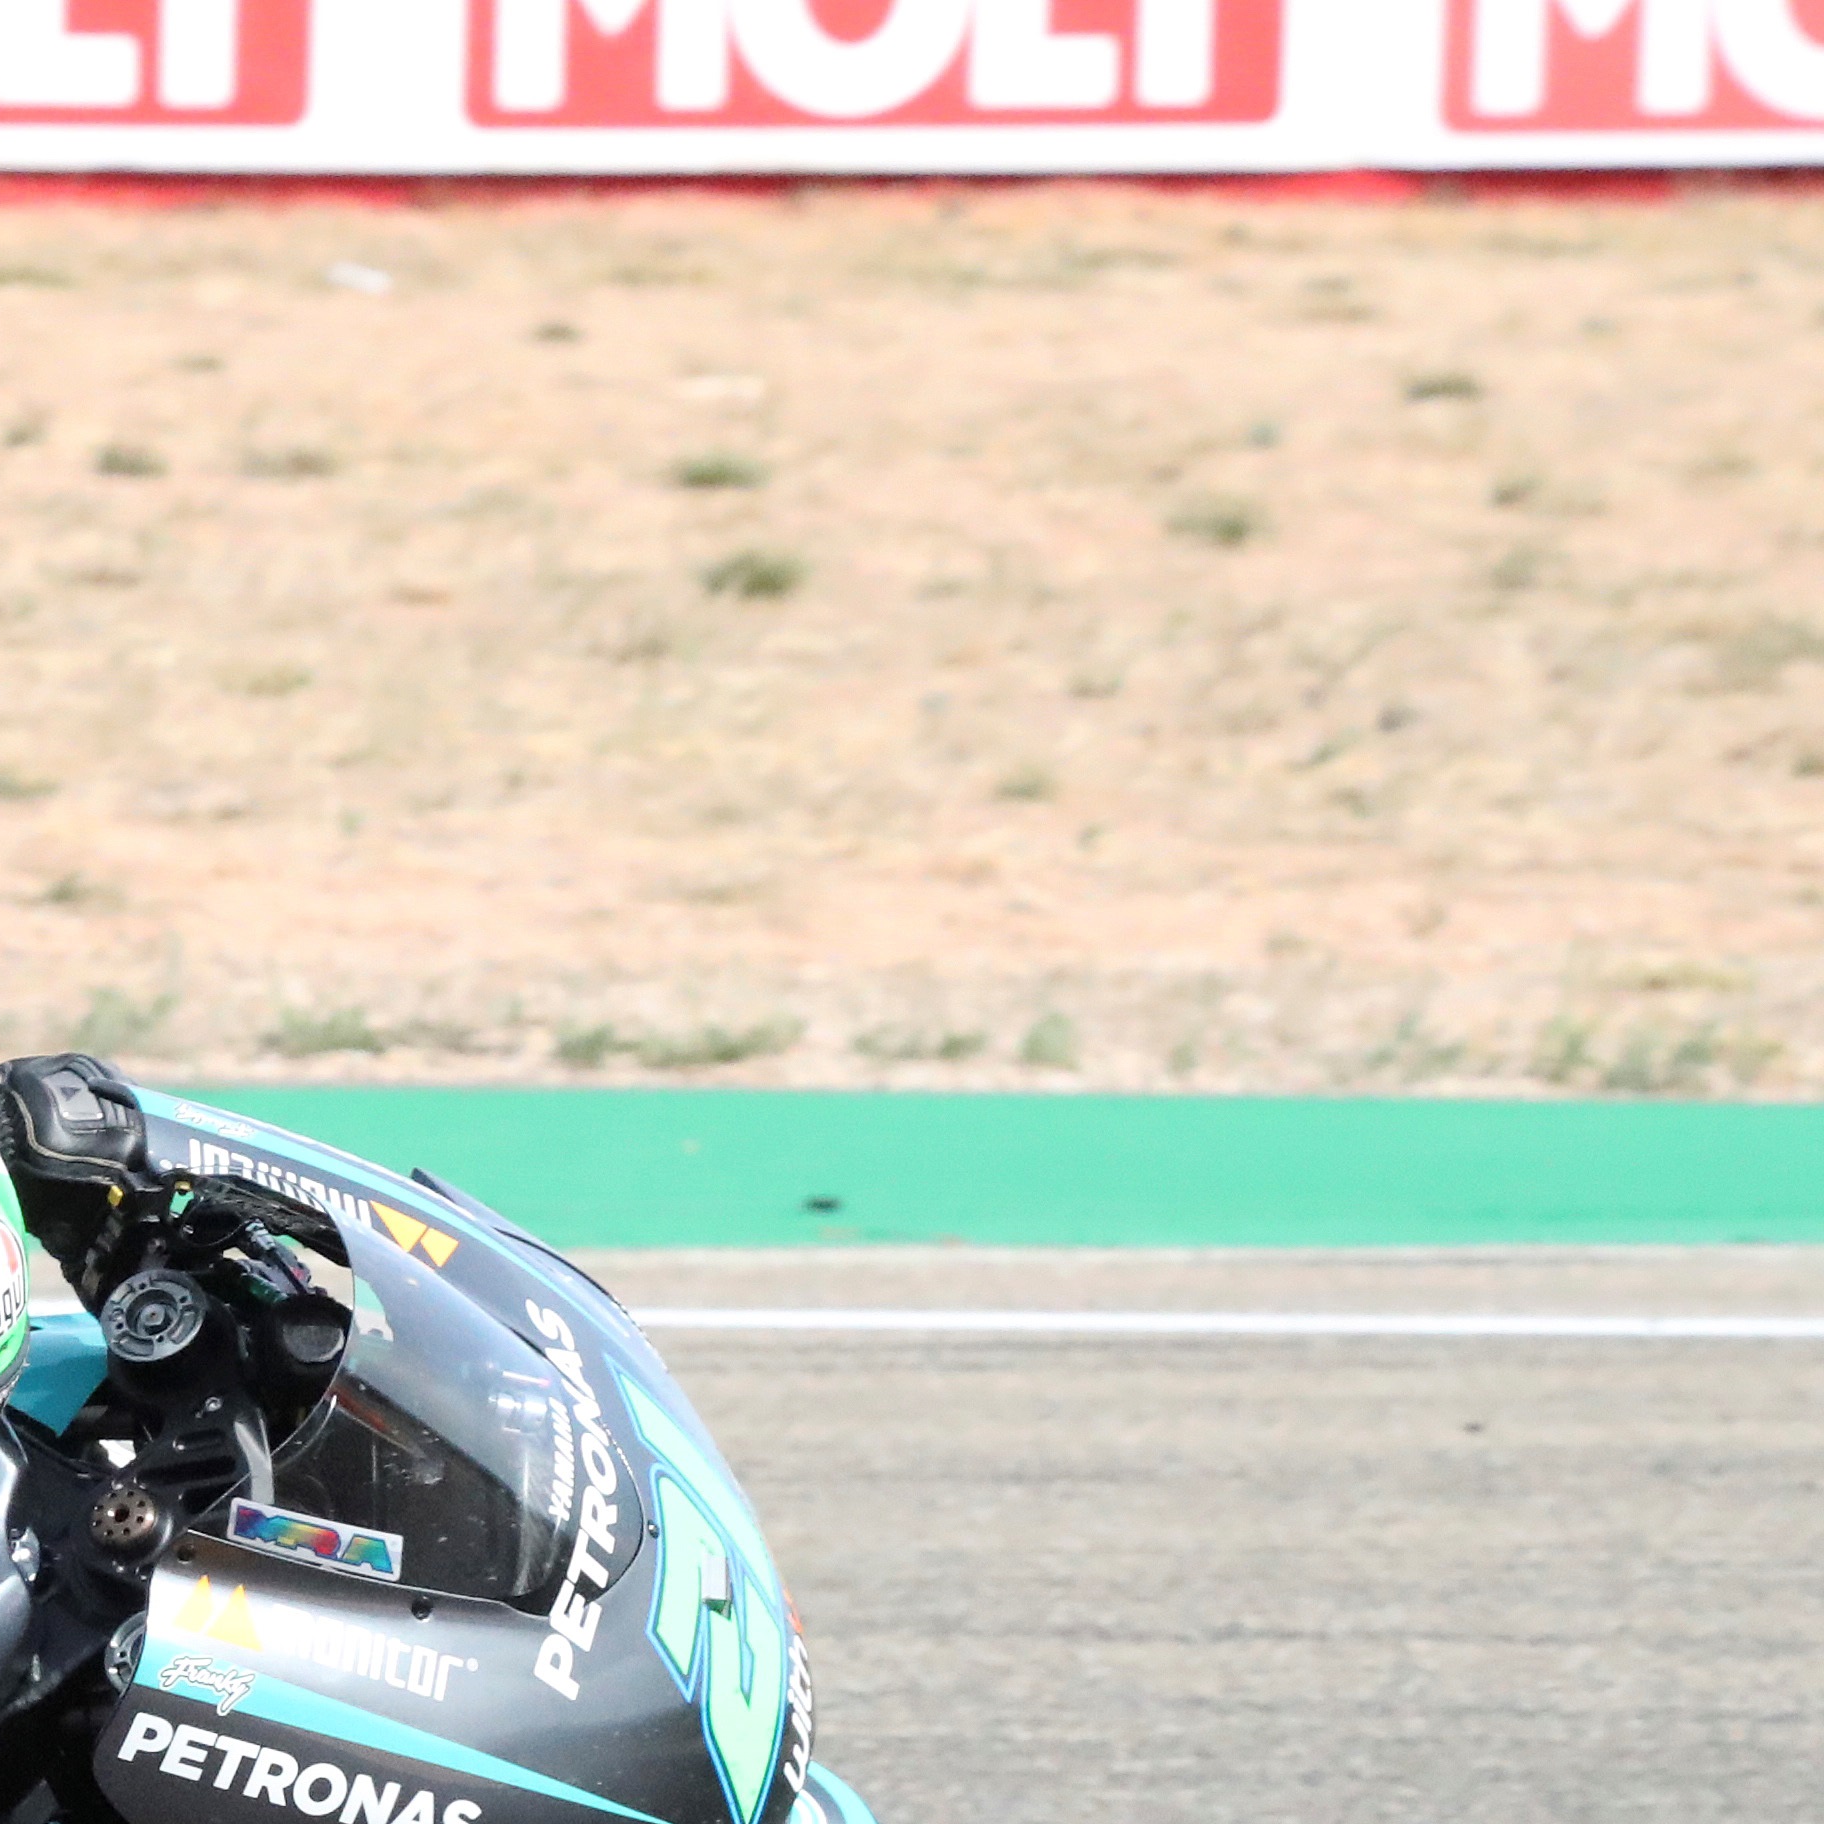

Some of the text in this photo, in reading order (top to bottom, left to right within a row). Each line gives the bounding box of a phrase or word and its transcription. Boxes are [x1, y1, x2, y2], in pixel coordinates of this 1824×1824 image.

[532, 1298, 619, 1701] PETRONAS
[549, 1397, 572, 1522] YAMAHA
[235, 1505, 393, 1573] MRA
[161, 1656, 255, 1712] Franky
